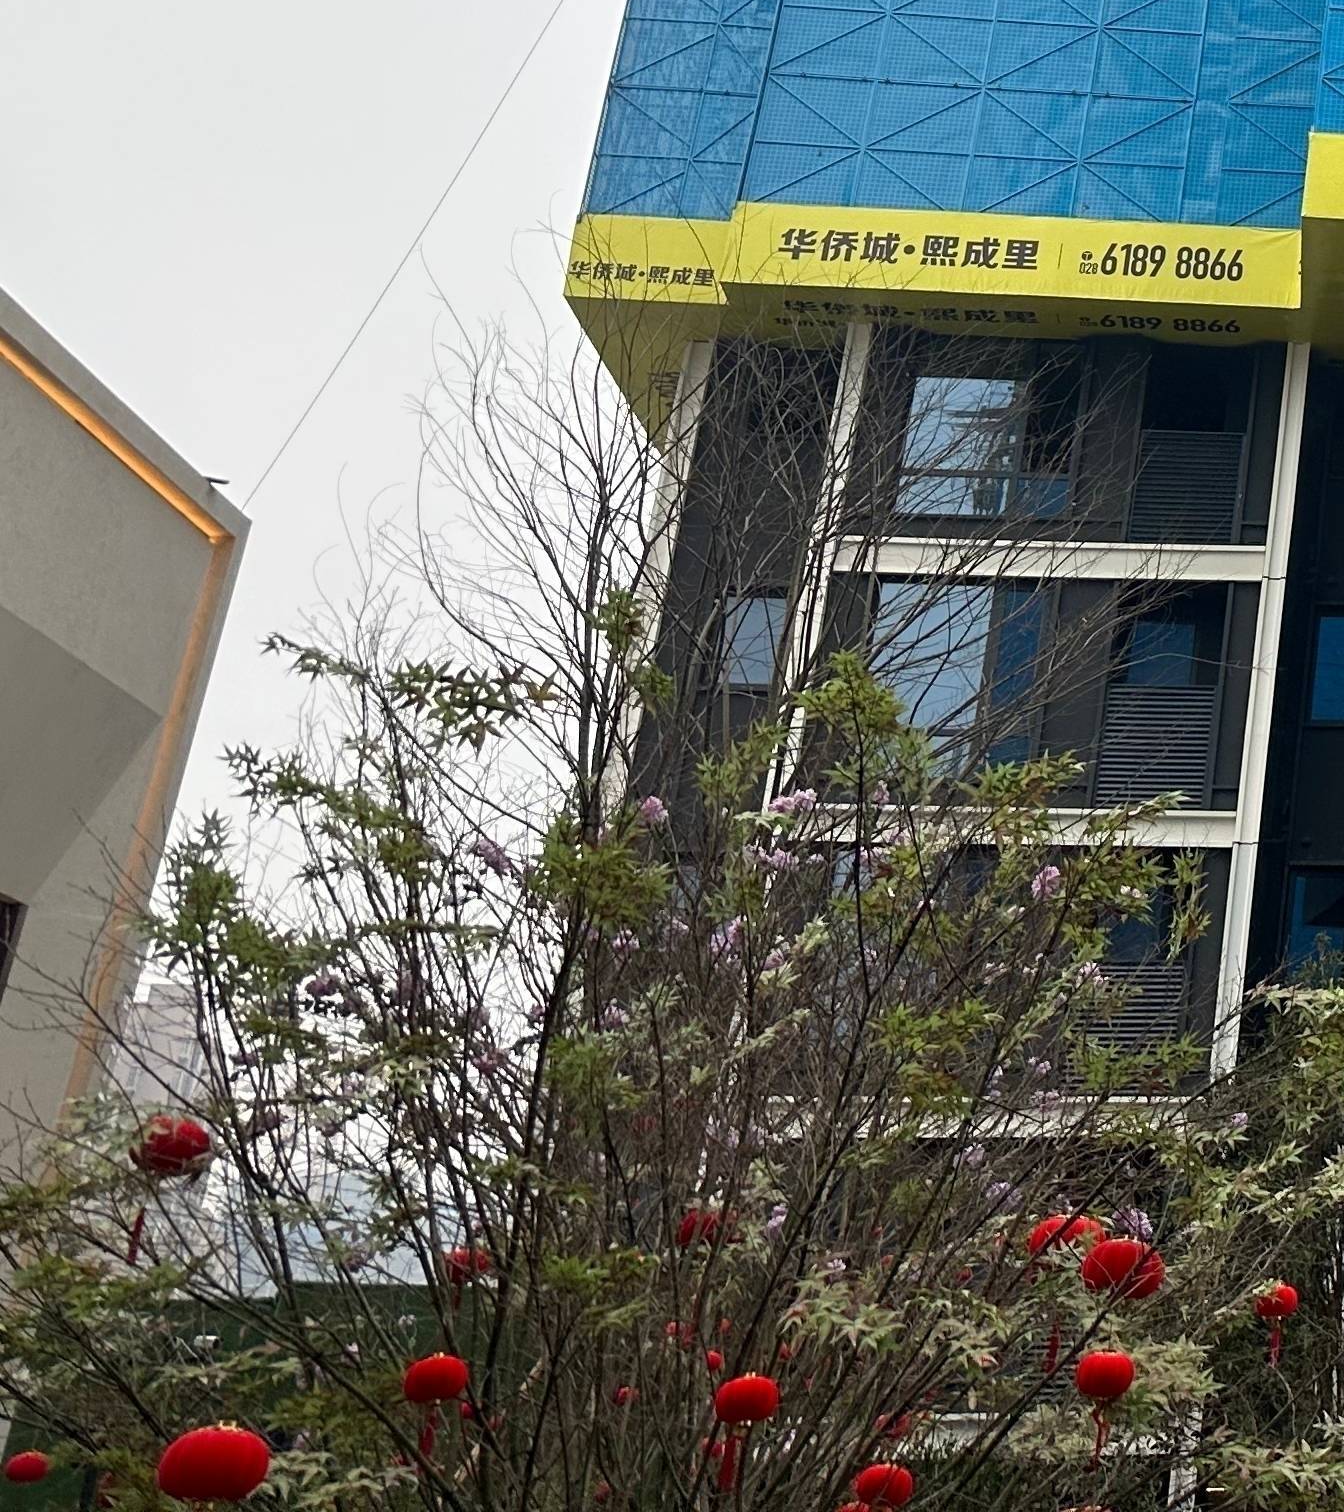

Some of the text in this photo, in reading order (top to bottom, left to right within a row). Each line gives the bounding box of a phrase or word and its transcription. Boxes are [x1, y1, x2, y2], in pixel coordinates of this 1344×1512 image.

[778, 228, 1040, 271] 华侨城·熙成里
[1100, 242, 1167, 278] 6189
[1175, 246, 1244, 282] 8866
[568, 260, 716, 287] 华侨城·熙成里
[1100, 314, 1163, 330] 6189
[1173, 318, 1241, 333] 8866
